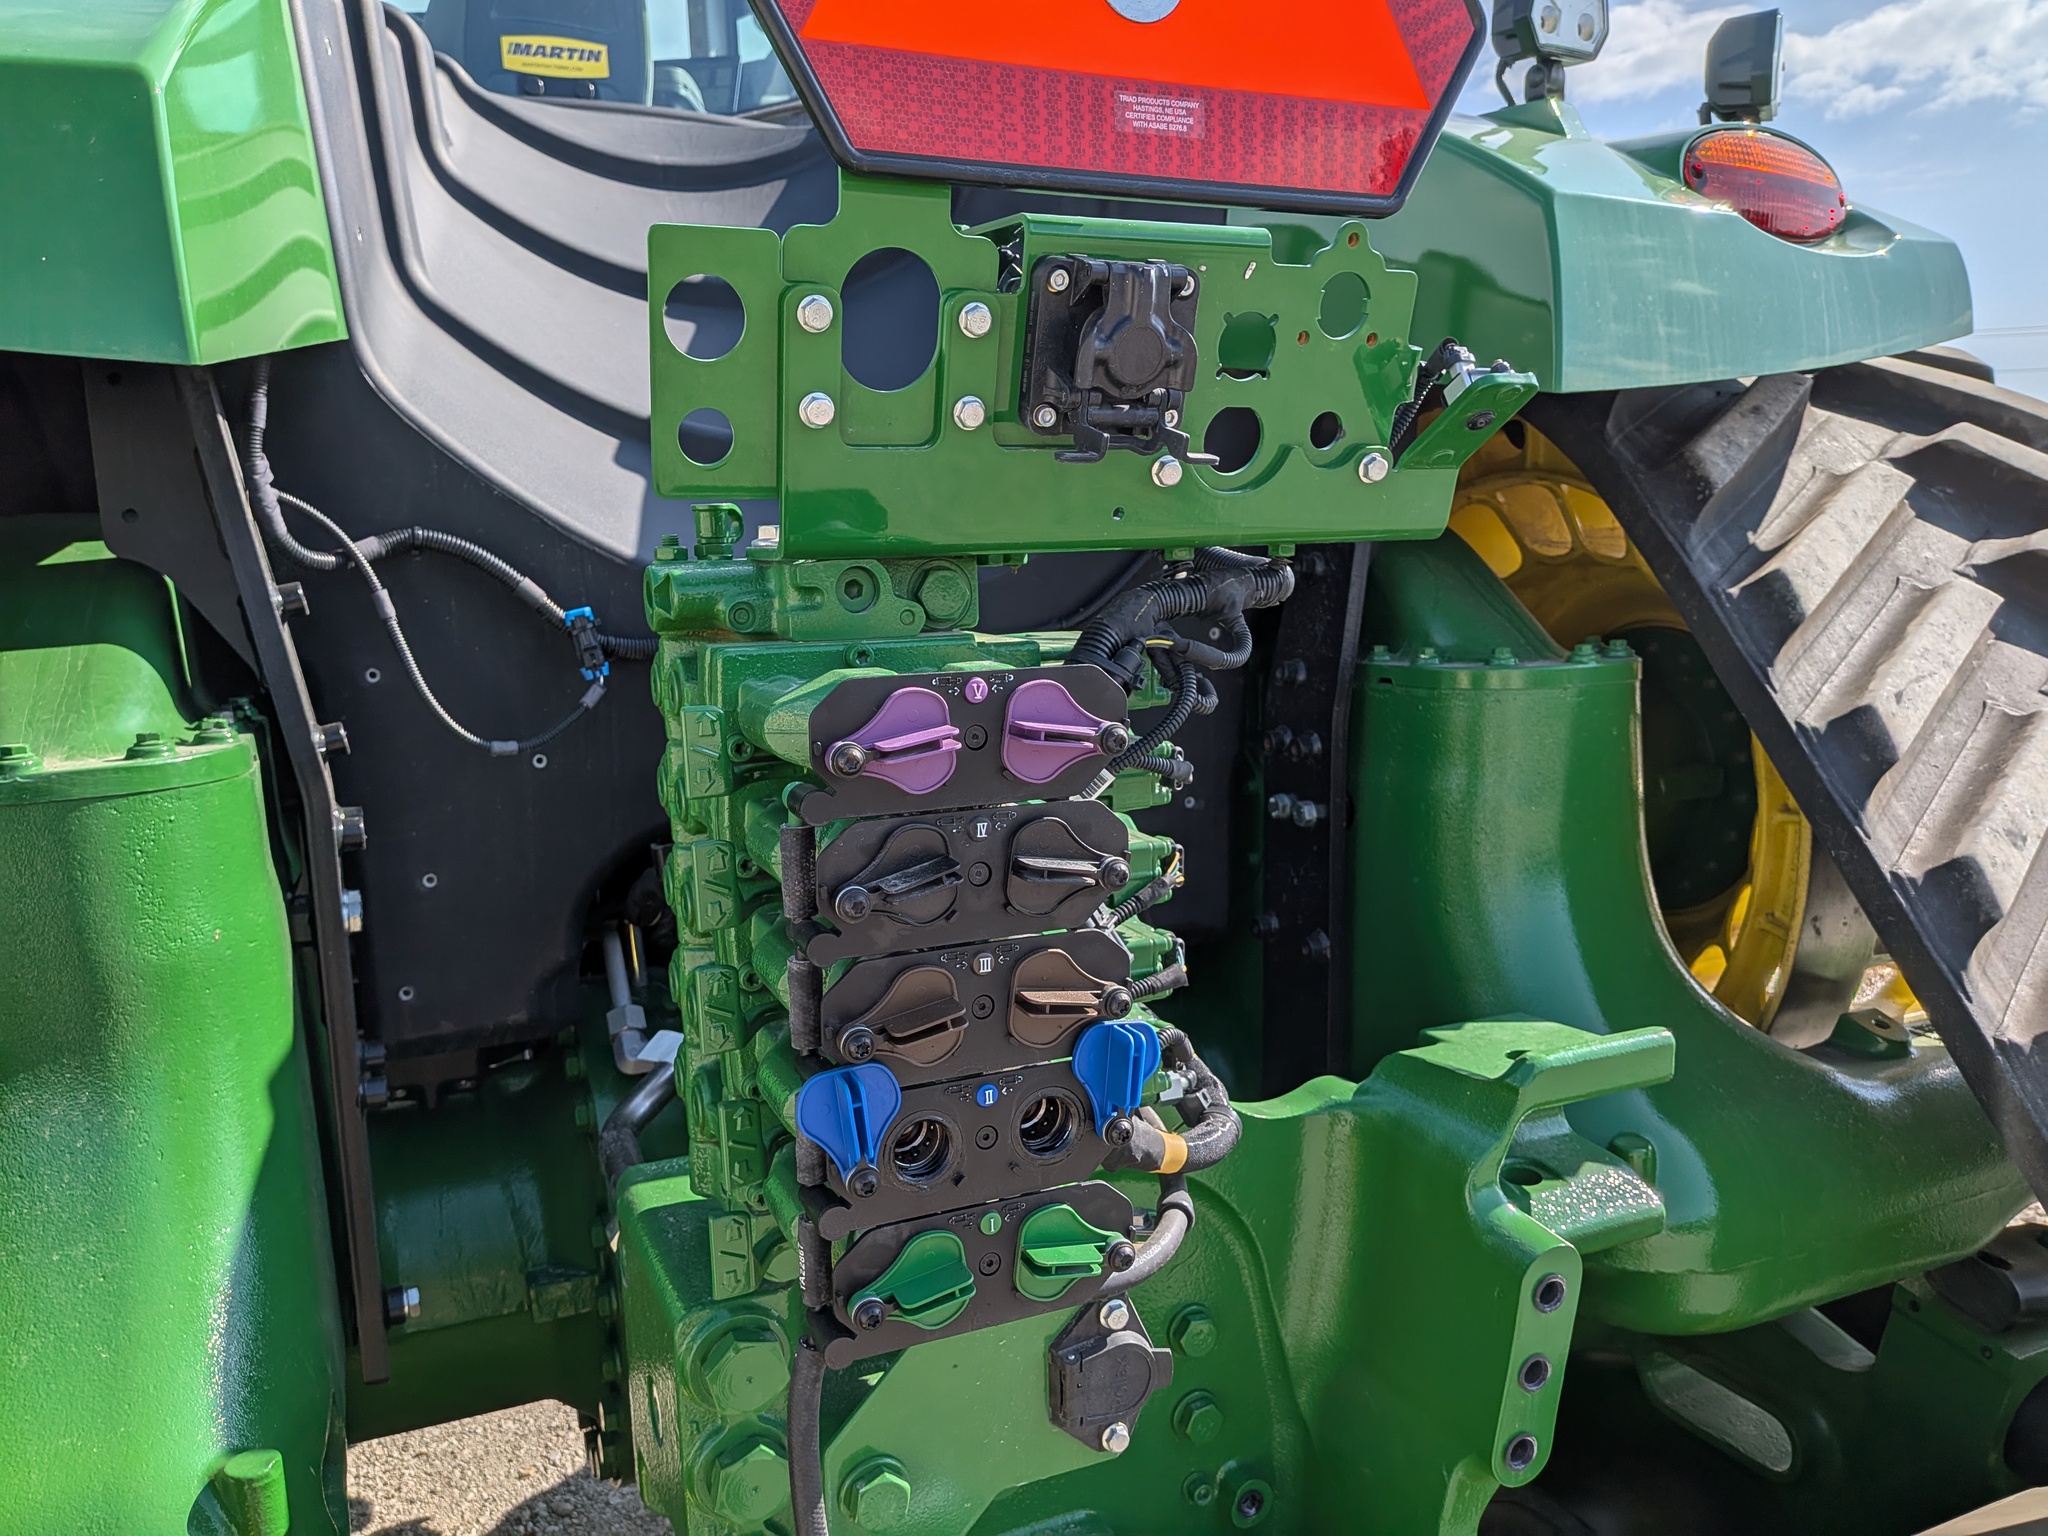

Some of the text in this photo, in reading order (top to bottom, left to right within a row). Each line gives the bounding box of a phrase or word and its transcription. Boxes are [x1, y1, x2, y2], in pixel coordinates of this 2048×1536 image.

[510, 42, 603, 62] MARTIN
[1138, 97, 1170, 106] PRODUCTS
[1171, 100, 1200, 109] COMPANY
[1125, 111, 1194, 124] CERTIFIES COMPLIANCE
[1165, 107, 1174, 115] NE
[1174, 108, 1187, 116] USA
[1149, 122, 1168, 130] ASABE
[976, 822, 988, 838] IV
[979, 957, 992, 973] III
[984, 1089, 994, 1105] II
